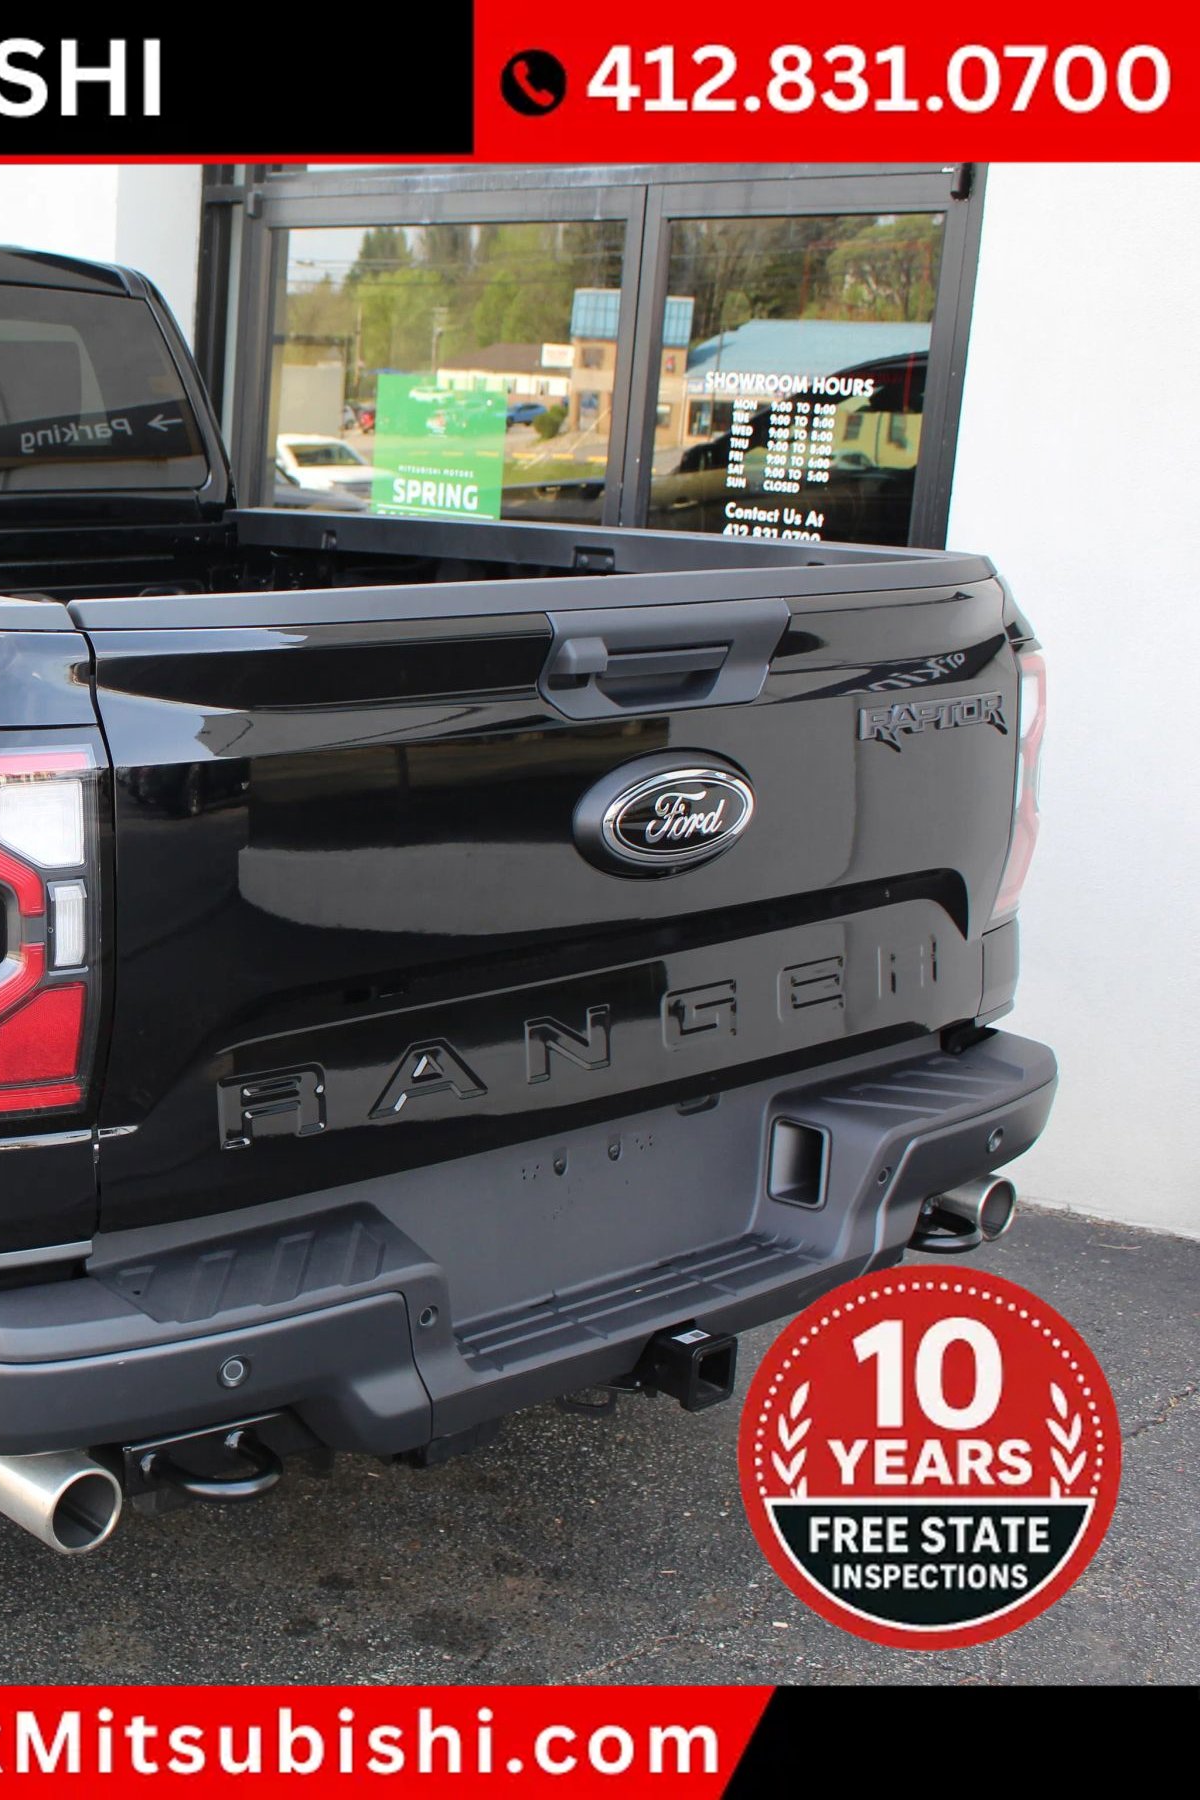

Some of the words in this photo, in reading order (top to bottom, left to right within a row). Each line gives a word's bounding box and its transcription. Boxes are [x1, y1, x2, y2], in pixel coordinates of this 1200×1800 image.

[705, 371, 810, 394] SHOWROOM
[812, 377, 874, 397] HOURS
[733, 400, 757, 411] MON
[770, 401, 792, 413] 9:00
[796, 402, 810, 414] TO
[813, 403, 836, 415] 8:00
[732, 412, 750, 424] TUE
[769, 414, 791, 426] 9:00
[794, 416, 808, 427] TO
[812, 417, 835, 429] 8:00
[731, 424, 753, 437] WED
[768, 427, 790, 439] 9:00
[793, 428, 807, 440] TO
[811, 430, 833, 442] 8:00
[730, 438, 749, 450] THU
[767, 441, 789, 452] 9:00
[792, 442, 806, 454] TO
[810, 443, 832, 456] 8:00
[728, 451, 744, 462] FRI
[766, 453, 786, 466] 9:00
[791, 455, 804, 466] TO
[808, 456, 831, 469] 6:00
[442, 468, 474, 478] MOTORS
[727, 464, 744, 475] SAT
[764, 467, 785, 479] 9:00
[789, 469, 802, 480] TO
[807, 470, 829, 483] 5:00
[392, 477, 479, 511] SPRING
[726, 476, 746, 488] SUN
[763, 480, 800, 494] CLOSED
[724, 502, 780, 523] Contact
[783, 508, 802, 525] Us
[804, 510, 825, 528] At
[857, 690, 1009, 752] RAPTOR
[645, 790, 726, 844] Ford
